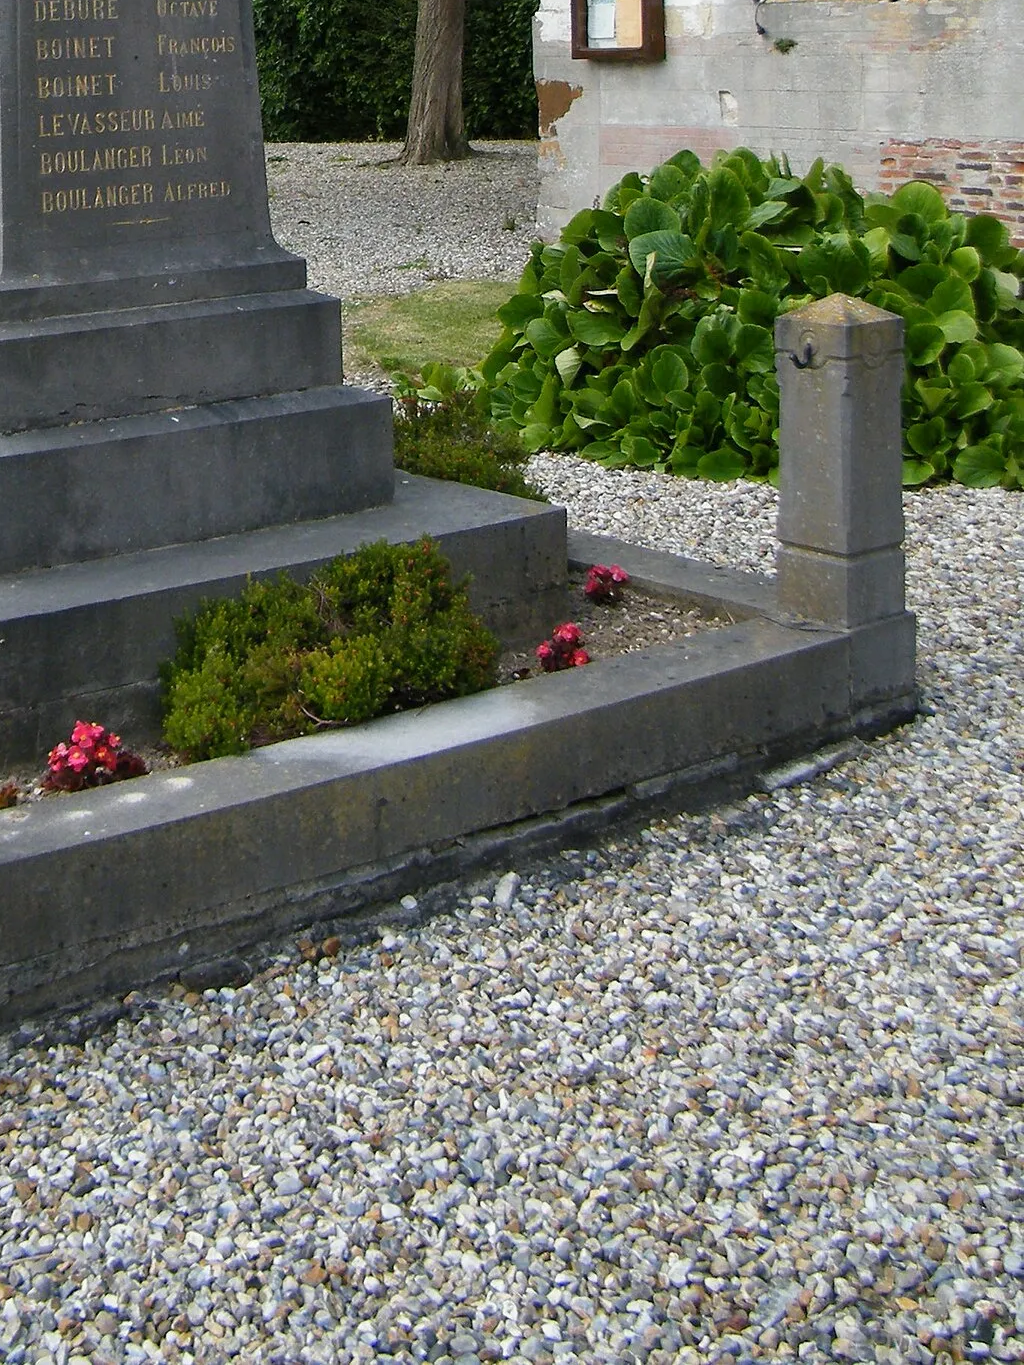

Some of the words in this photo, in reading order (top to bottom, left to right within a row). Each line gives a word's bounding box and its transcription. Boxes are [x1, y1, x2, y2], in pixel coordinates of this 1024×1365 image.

[36, 36, 115, 61] BOINET
[157, 34, 236, 59] FRANÇOIS
[37, 73, 117, 99] BOINET
[159, 71, 213, 93] LOUIS
[39, 109, 155, 137] LEVASSEUR
[40, 145, 152, 175] BOULANGER
[42, 183, 154, 213] BOULANGER
[164, 181, 231, 202] ALFRED
